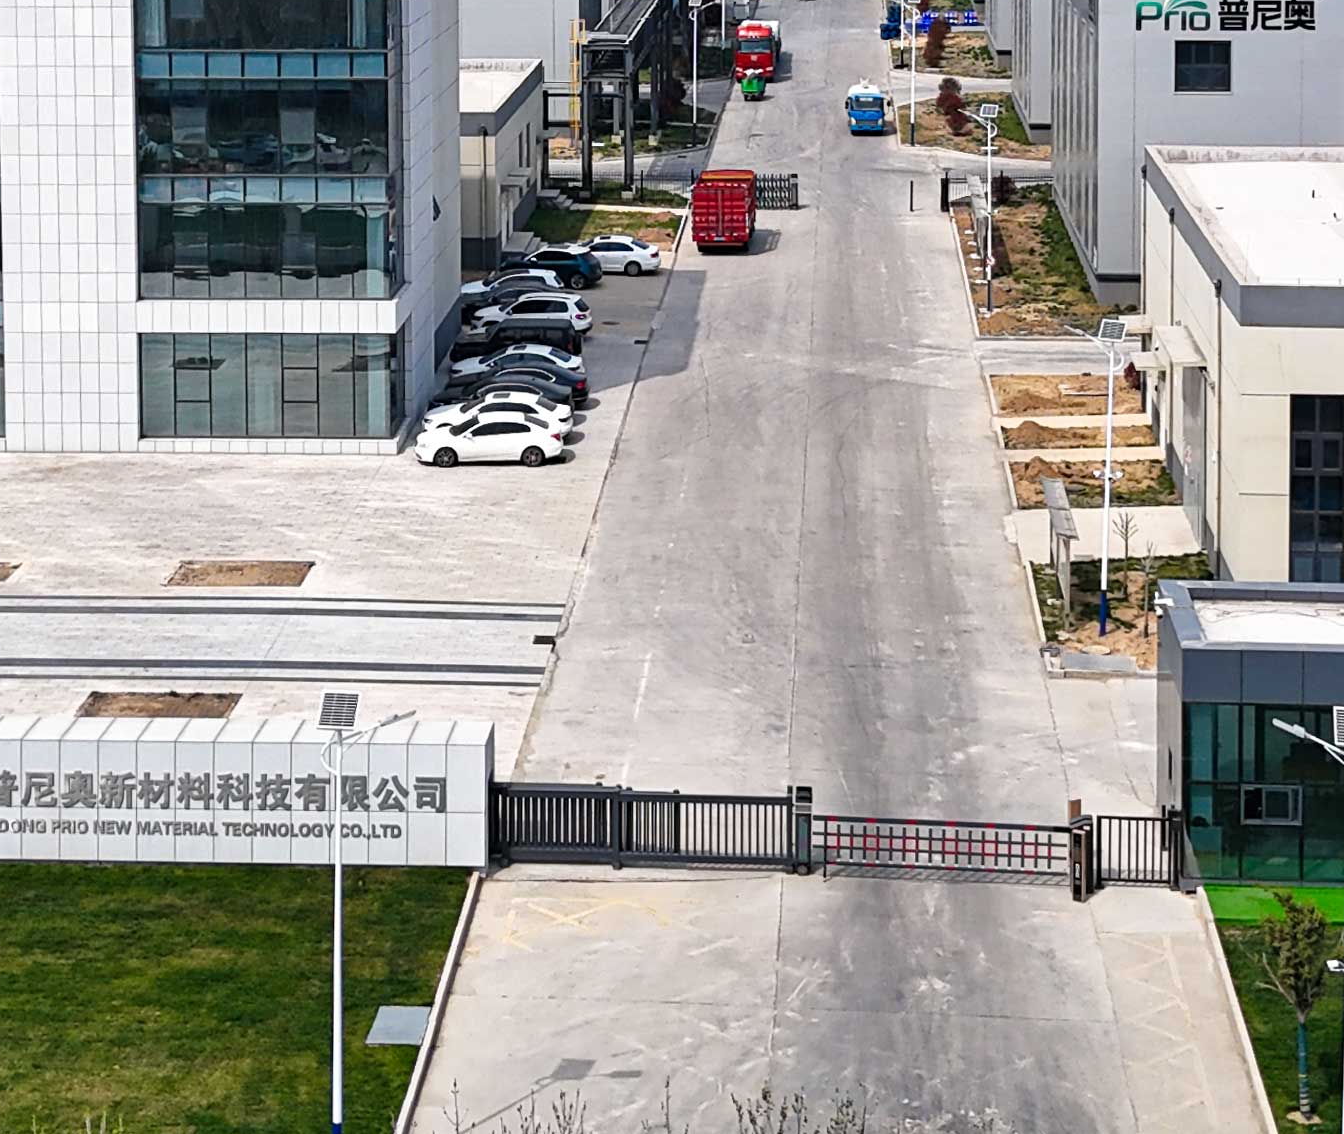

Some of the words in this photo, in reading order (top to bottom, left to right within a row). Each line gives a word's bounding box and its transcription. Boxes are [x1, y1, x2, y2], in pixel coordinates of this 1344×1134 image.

[1136, 1, 1211, 31] Prio
[1218, 0, 1316, 31] 普尼奥
[51, 819, 89, 836] PRIO
[94, 820, 132, 836] NEW
[136, 821, 218, 837] MATERIAL
[222, 822, 335, 839] TECHNOLOGY
